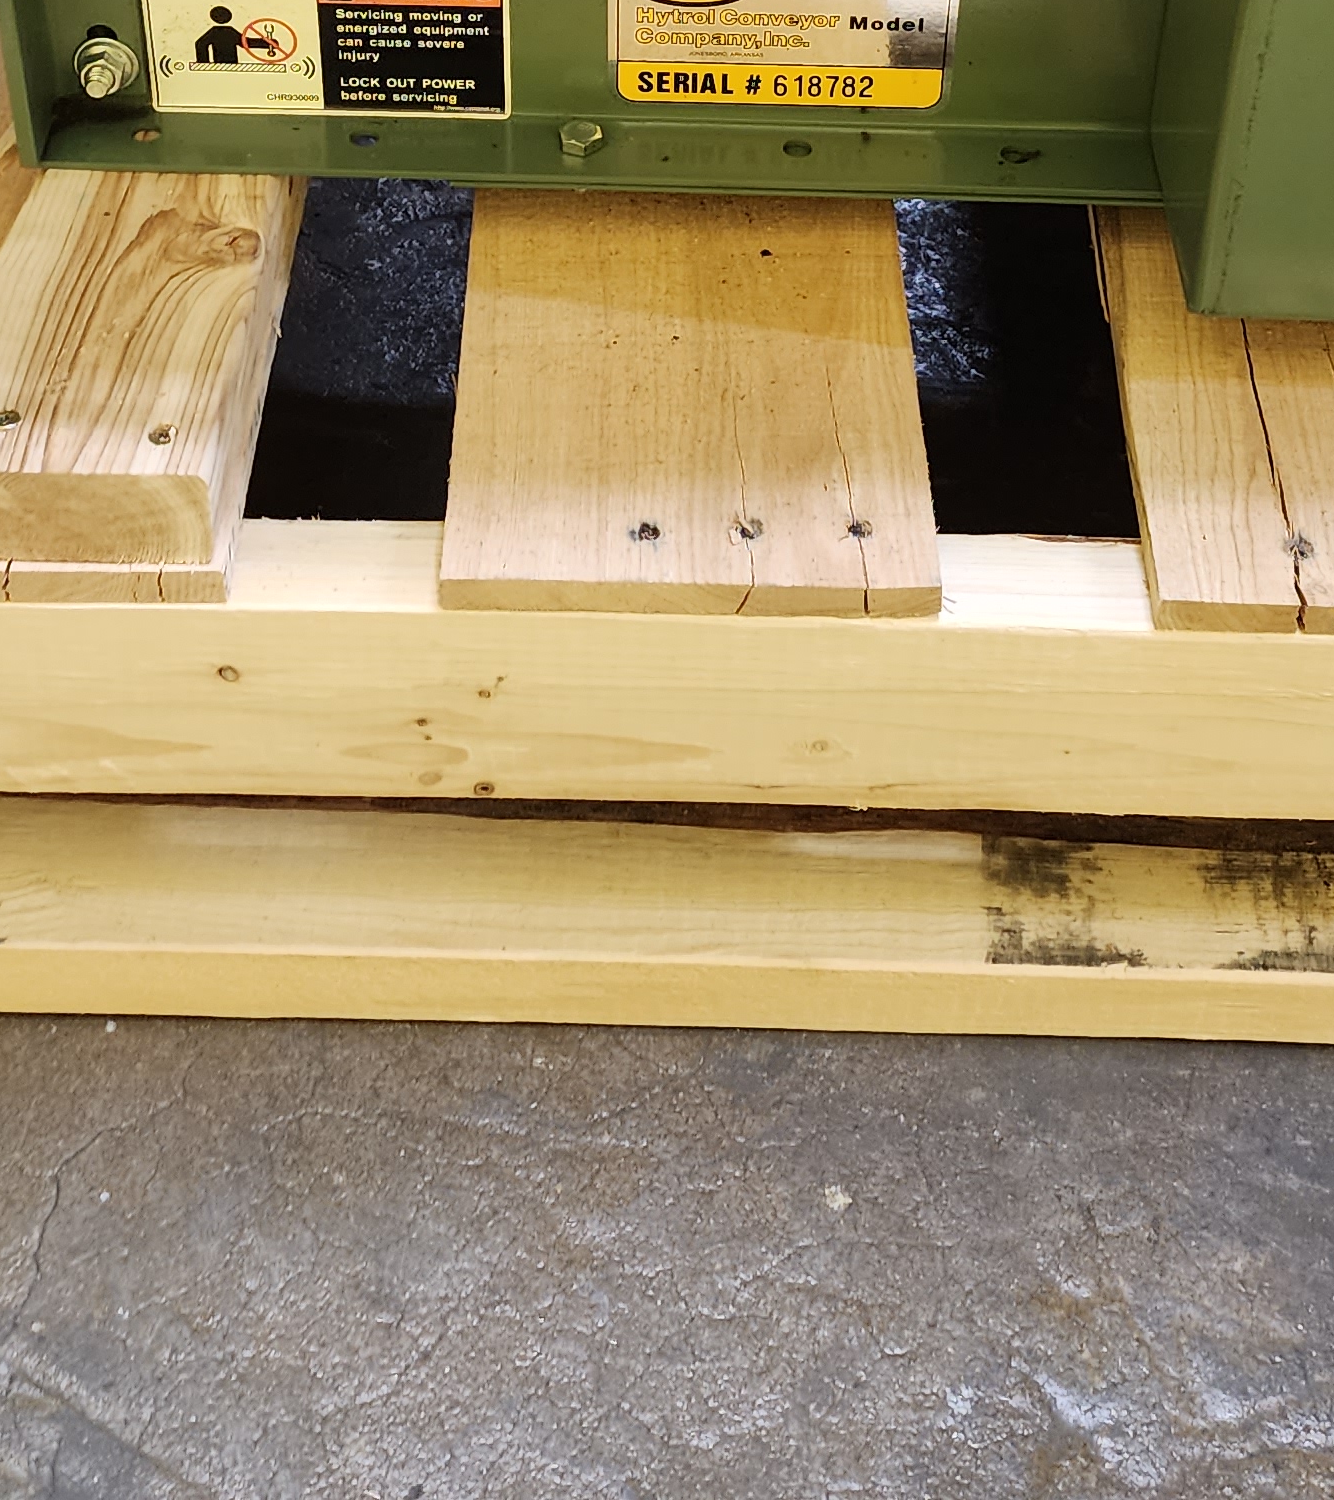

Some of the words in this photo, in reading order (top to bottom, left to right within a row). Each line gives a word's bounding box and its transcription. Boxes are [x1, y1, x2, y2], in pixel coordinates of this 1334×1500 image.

[335, 9, 403, 22] Servicing
[409, 11, 462, 23] moving
[467, 12, 483, 21] or
[635, 6, 715, 28] Hytrol
[719, 11, 841, 31] Conveyor
[849, 16, 925, 32] Model
[336, 23, 407, 35] energized
[413, 25, 489, 36] equipment
[337, 38, 363, 47] can
[369, 39, 412, 48] cause
[417, 40, 465, 49] severe
[338, 49, 380, 63] injury
[340, 77, 381, 88] LOCK
[386, 78, 416, 88] OUT
[422, 78, 476, 90] POWER
[637, 71, 734, 95] SERIAL
[745, 74, 762, 95] #
[773, 74, 874, 98] 618782
[340, 90, 386, 101] before
[392, 91, 458, 105] servicing
